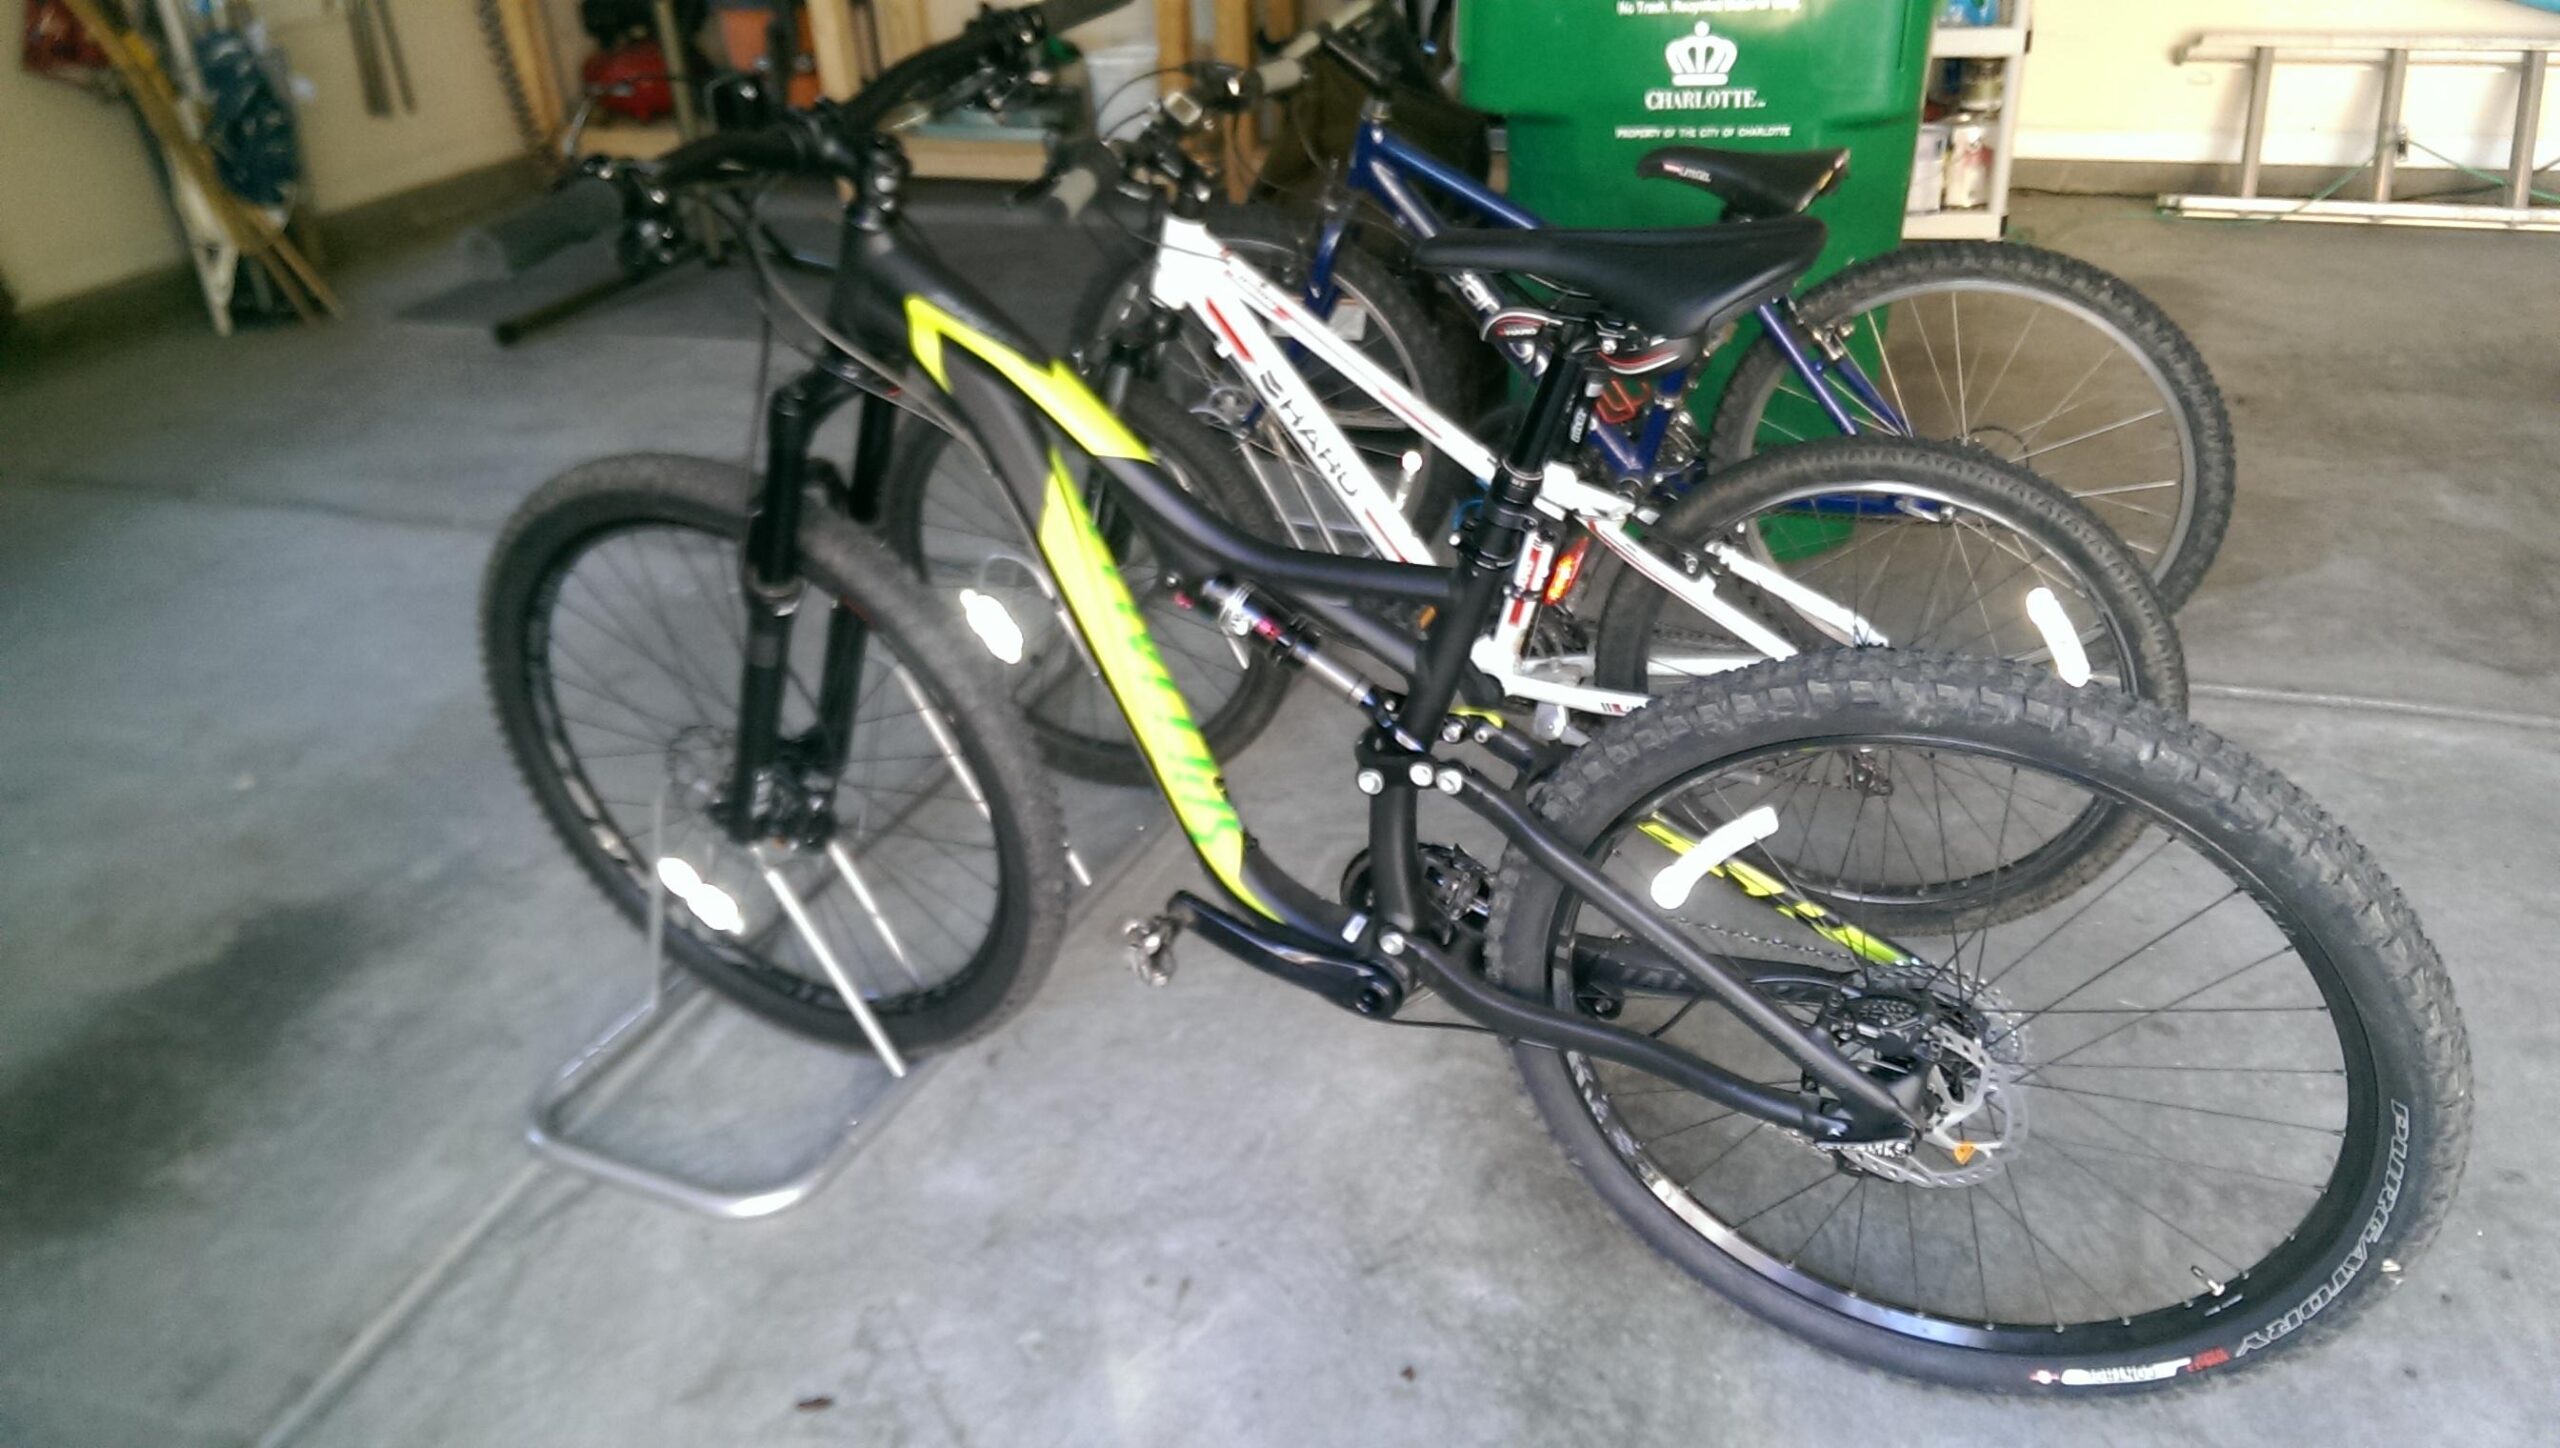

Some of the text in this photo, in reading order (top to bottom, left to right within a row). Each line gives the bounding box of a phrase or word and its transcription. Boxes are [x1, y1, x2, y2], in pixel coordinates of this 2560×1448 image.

[1616, 1, 1635, 15] No
[1645, 90, 1757, 109] CHARLOTTE
[1615, 126, 1792, 138] PROPERTY OF THE CITY OF CHARLOTTE
[2235, 1099, 2410, 1357] PURGATORY
